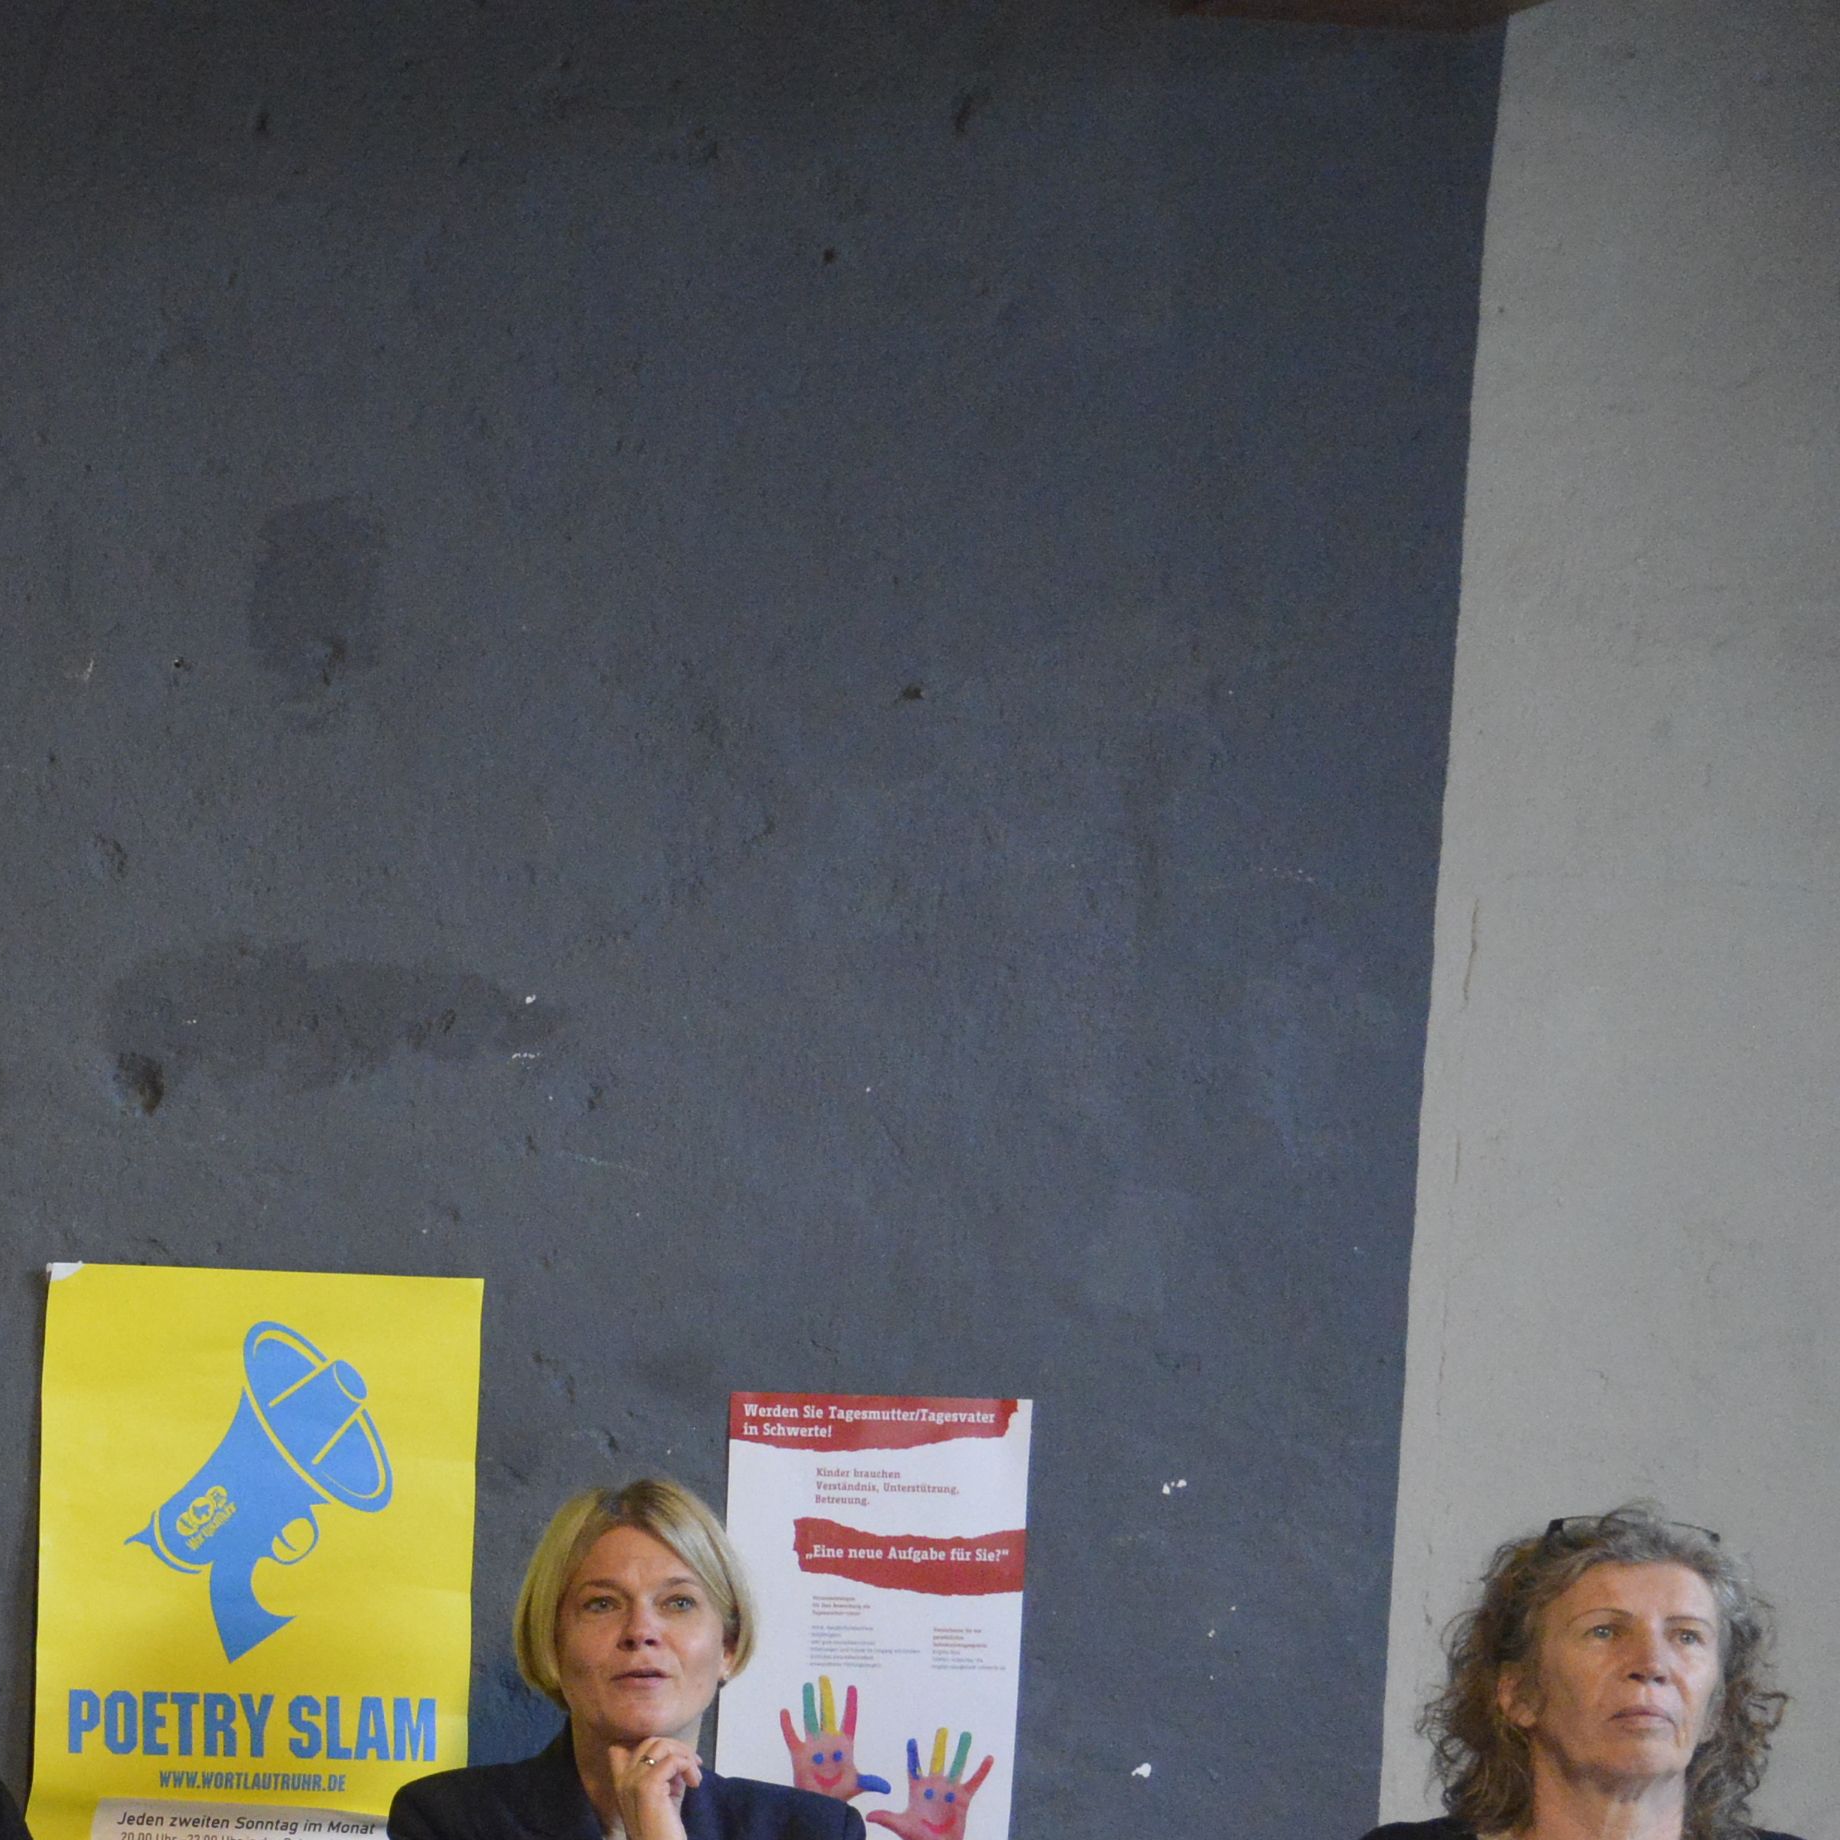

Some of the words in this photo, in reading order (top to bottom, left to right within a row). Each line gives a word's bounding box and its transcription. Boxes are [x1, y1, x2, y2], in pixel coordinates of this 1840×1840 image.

[743, 1404, 798, 1418] Werden
[803, 1405, 823, 1419] Sie
[829, 1406, 995, 1424] Tagesmutter/Tagesvater
[743, 1423, 758, 1436] in
[763, 1423, 832, 1438] Schwerte!
[817, 1468, 849, 1478] Kinder
[854, 1469, 900, 1479] brauchen
[817, 1481, 879, 1493] Verständnis,
[815, 1495, 870, 1506] Betreuung.
[848, 1548, 882, 1559] neue
[887, 1547, 945, 1563] Aufgabe
[950, 1547, 970, 1561] für
[68, 1689, 274, 1758] POETRY
[288, 1695, 437, 1762] SLAM
[159, 1770, 345, 1792] WWW.WORTLAUTRUHR.DE
[118, 1812, 164, 1827] Jeden
[170, 1814, 229, 1830] zweiten
[235, 1816, 299, 1835] Sonntag
[304, 1819, 321, 1832] im
[328, 1822, 376, 1835] Monat
